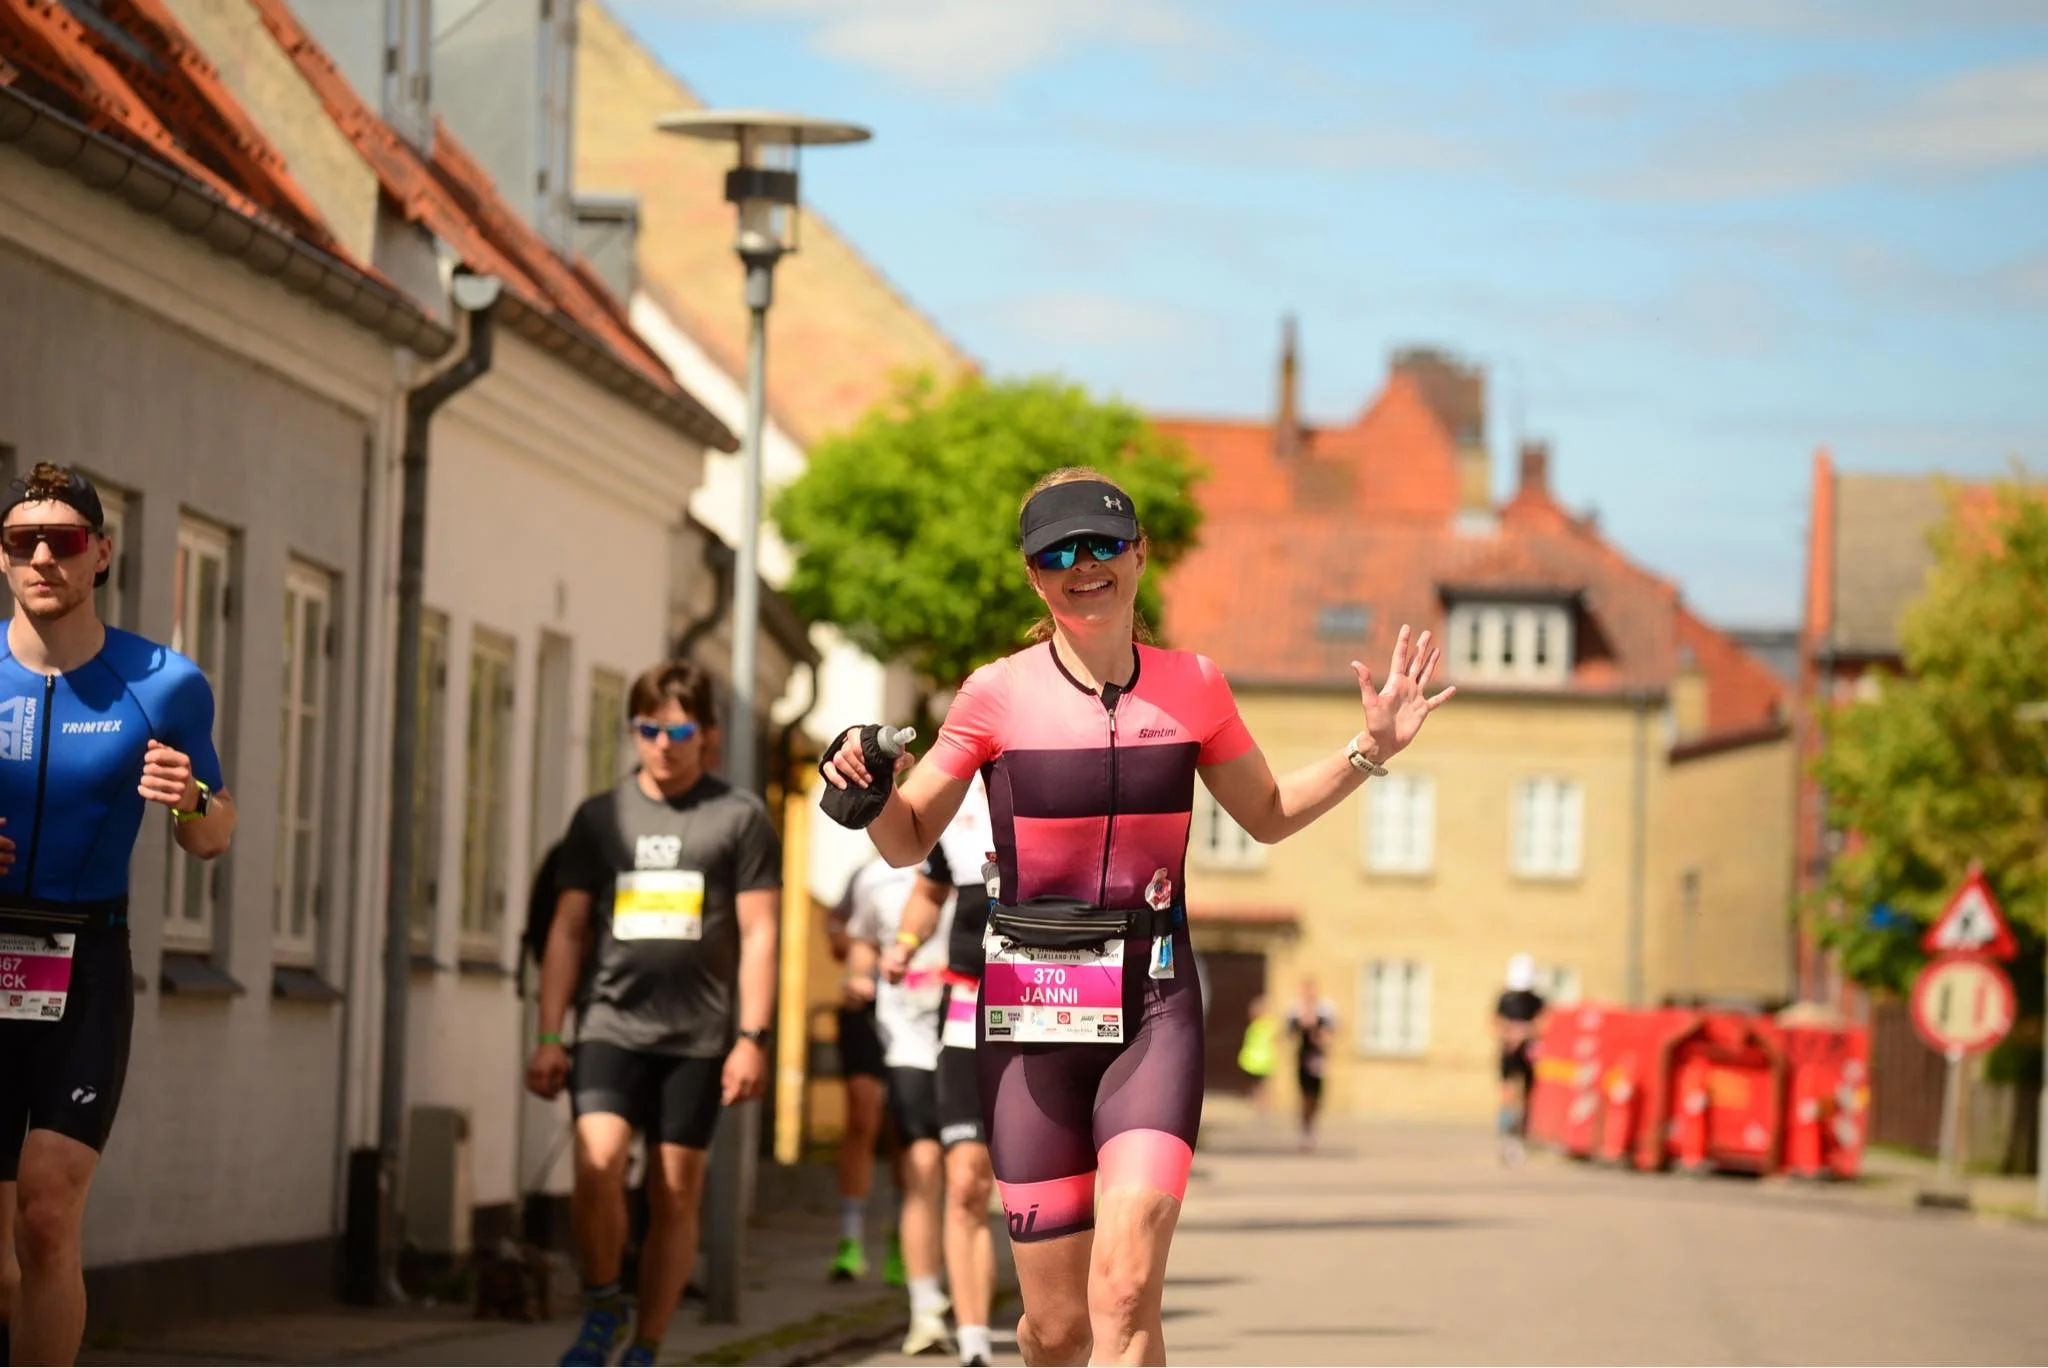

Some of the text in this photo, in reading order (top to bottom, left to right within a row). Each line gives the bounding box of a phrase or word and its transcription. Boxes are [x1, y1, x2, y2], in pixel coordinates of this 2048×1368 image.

[22, 697, 37, 761] TRIATHLON
[62, 720, 122, 734] TRIMTEX
[1138, 727, 1177, 739] Santini
[1033, 967, 1066, 985] 370
[1020, 987, 1078, 1004] JANNI
